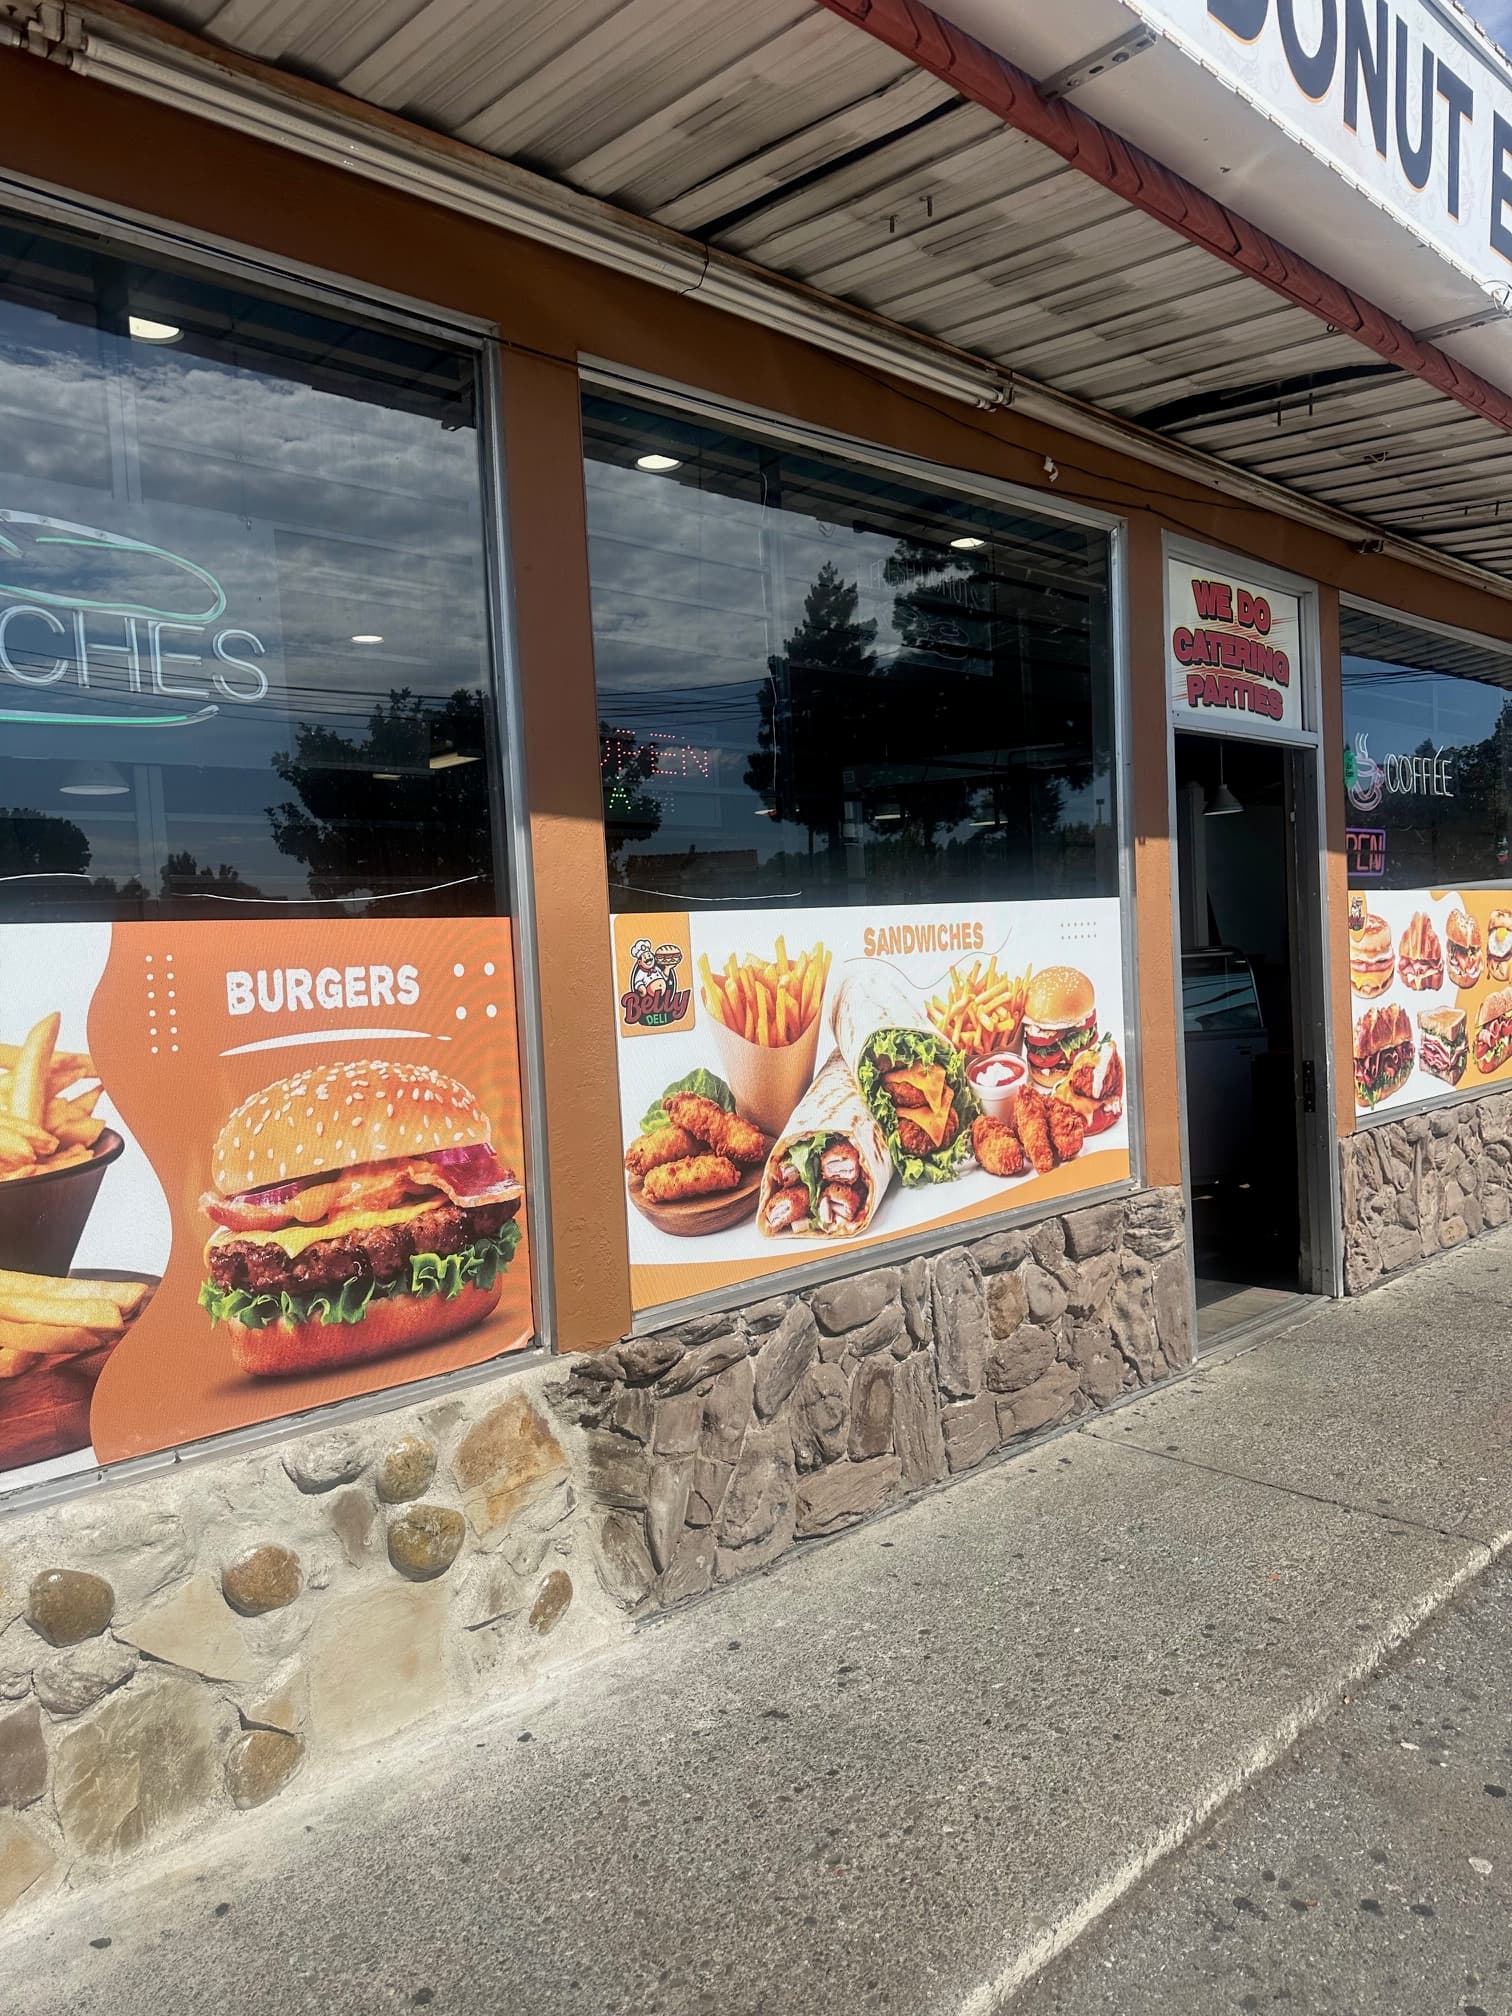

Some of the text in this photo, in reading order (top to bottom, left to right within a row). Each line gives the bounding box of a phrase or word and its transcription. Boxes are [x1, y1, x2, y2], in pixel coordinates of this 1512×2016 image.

[1206, 0, 1474, 223] ONUT
[1191, 580, 1271, 635] WE DO
[0, 605, 269, 702] CHES
[1172, 626, 1290, 687] CATERING
[1186, 674, 1284, 721] PARTIES
[863, 922, 984, 957] SANDWICHES
[226, 964, 420, 1016] BURGERS
[621, 989, 692, 1024] Belly
[646, 1013, 668, 1025] DELI
